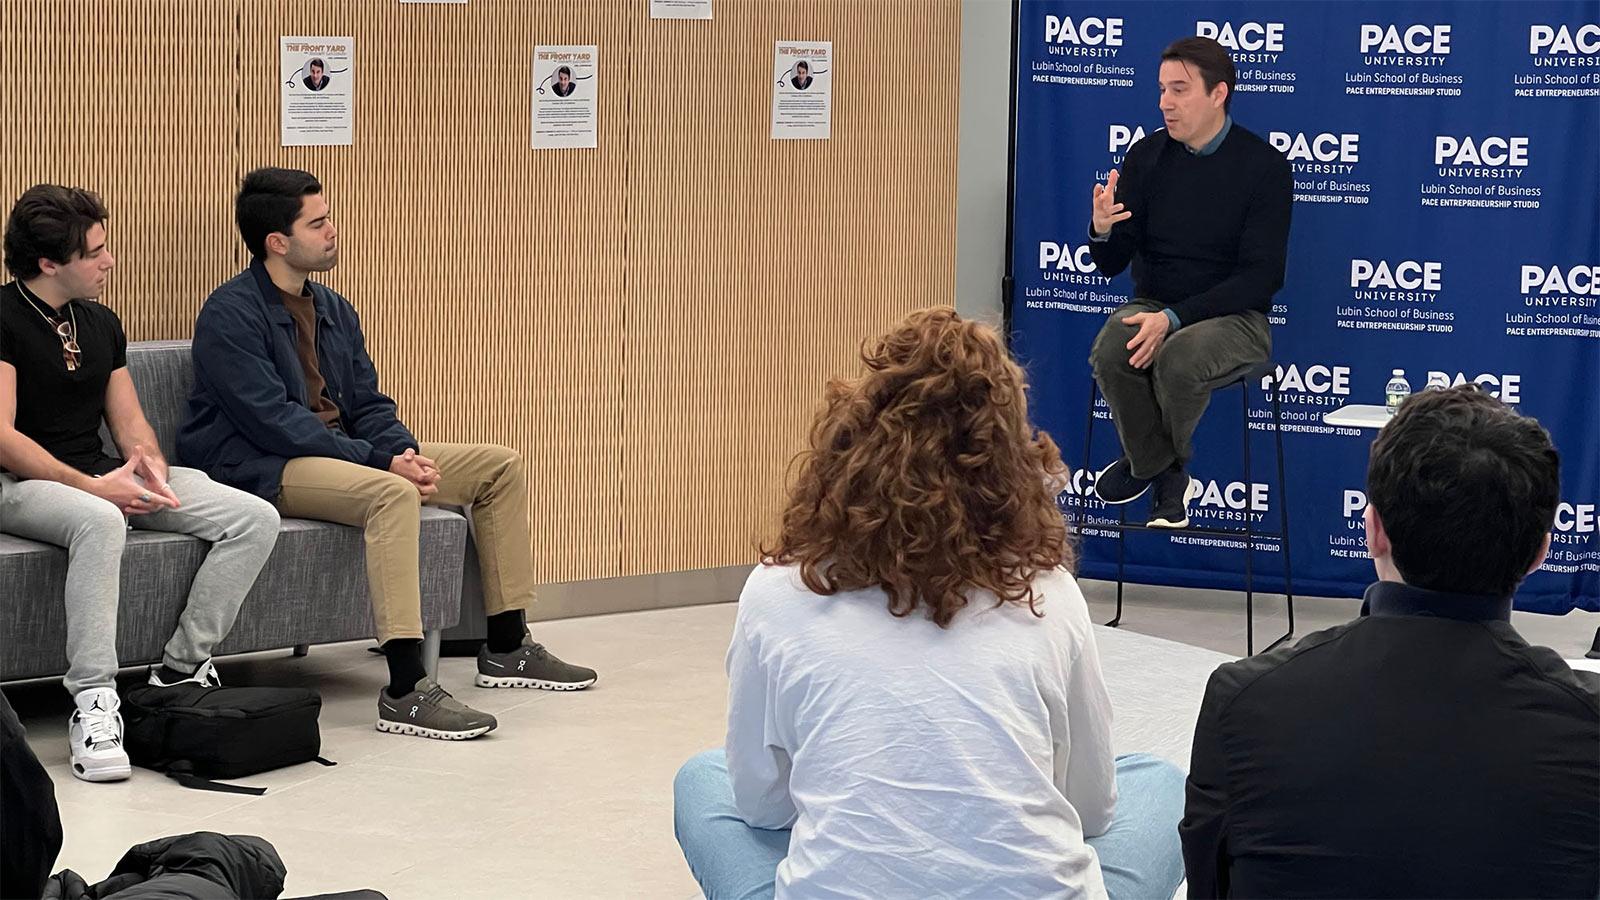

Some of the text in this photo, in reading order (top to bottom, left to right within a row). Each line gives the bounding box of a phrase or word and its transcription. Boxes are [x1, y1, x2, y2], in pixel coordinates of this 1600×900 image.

[1045, 15, 1123, 46] PACE
[1360, 24, 1451, 54] PACE
[1530, 24, 1600, 54] PAC
[1049, 46, 1118, 58] UNIVERSITY
[1230, 54, 1278, 63] ERSITY
[1364, 56, 1445, 66] UNIVERSITY
[1534, 57, 1600, 66] UNIVERSI
[1032, 61, 1134, 75] Lubin School of Business
[1032, 74, 1134, 87] PACE ENTREPRENEURSHIP STUDIO
[1242, 70, 1253, 80] of
[1255, 70, 1296, 81] Business
[1345, 72, 1463, 84] Lubin School of Business
[1514, 74, 1542, 84] Lubin
[1544, 74, 1578, 84] School
[1580, 74, 1591, 84] of
[1234, 84, 1294, 93] NEURSHIP STUDIO
[1346, 87, 1462, 96] PACE ENTREPRENEURSHIP STUDIO
[1434, 136, 1529, 166] PACE
[1291, 164, 1353, 174] IVERSITY
[1439, 168, 1522, 178] UNIVERSITY
[1294, 180, 1370, 192] hool of Business
[1421, 184, 1542, 196] Lubin School of Business
[1344, 196, 1368, 204] STUDIO
[1422, 198, 1540, 208] PACE ENTREPRENEURSHIP STUDIO
[1040, 242, 1097, 273] PAC
[1044, 272, 1112, 285] UNIVERSITY
[1350, 259, 1442, 290] PACE
[1520, 265, 1600, 295] PACE
[1026, 287, 1128, 304] Lubin School of Business
[1355, 290, 1436, 302] UNIVERSITY
[1026, 300, 1044, 309] PACE
[1045, 301, 1102, 314] ENTREPRENEURSHIP
[1336, 306, 1454, 320] Lubin School of Business
[1268, 316, 1286, 325] UDIO
[1506, 313, 1532, 323] Lubin
[1536, 314, 1570, 324] School
[1572, 314, 1582, 324] of
[1337, 320, 1453, 332] PACE ENTREPRENEURSHIP STUDIO
[1248, 408, 1273, 418] Lubin
[1280, 410, 1308, 421] chool
[1310, 411, 1320, 421] of
[1248, 422, 1362, 436] PACE ENREPRENEURSHIP STUDIO
[1554, 502, 1595, 532] CE
[1170, 536, 1187, 544] PACE
[1256, 544, 1280, 552] STUDIO
[1330, 534, 1356, 546] Lubin
[1553, 534, 1590, 544] RSITY
[1330, 549, 1348, 558] PACE
[1554, 550, 1564, 560] of
[1566, 551, 1600, 561] Busines
